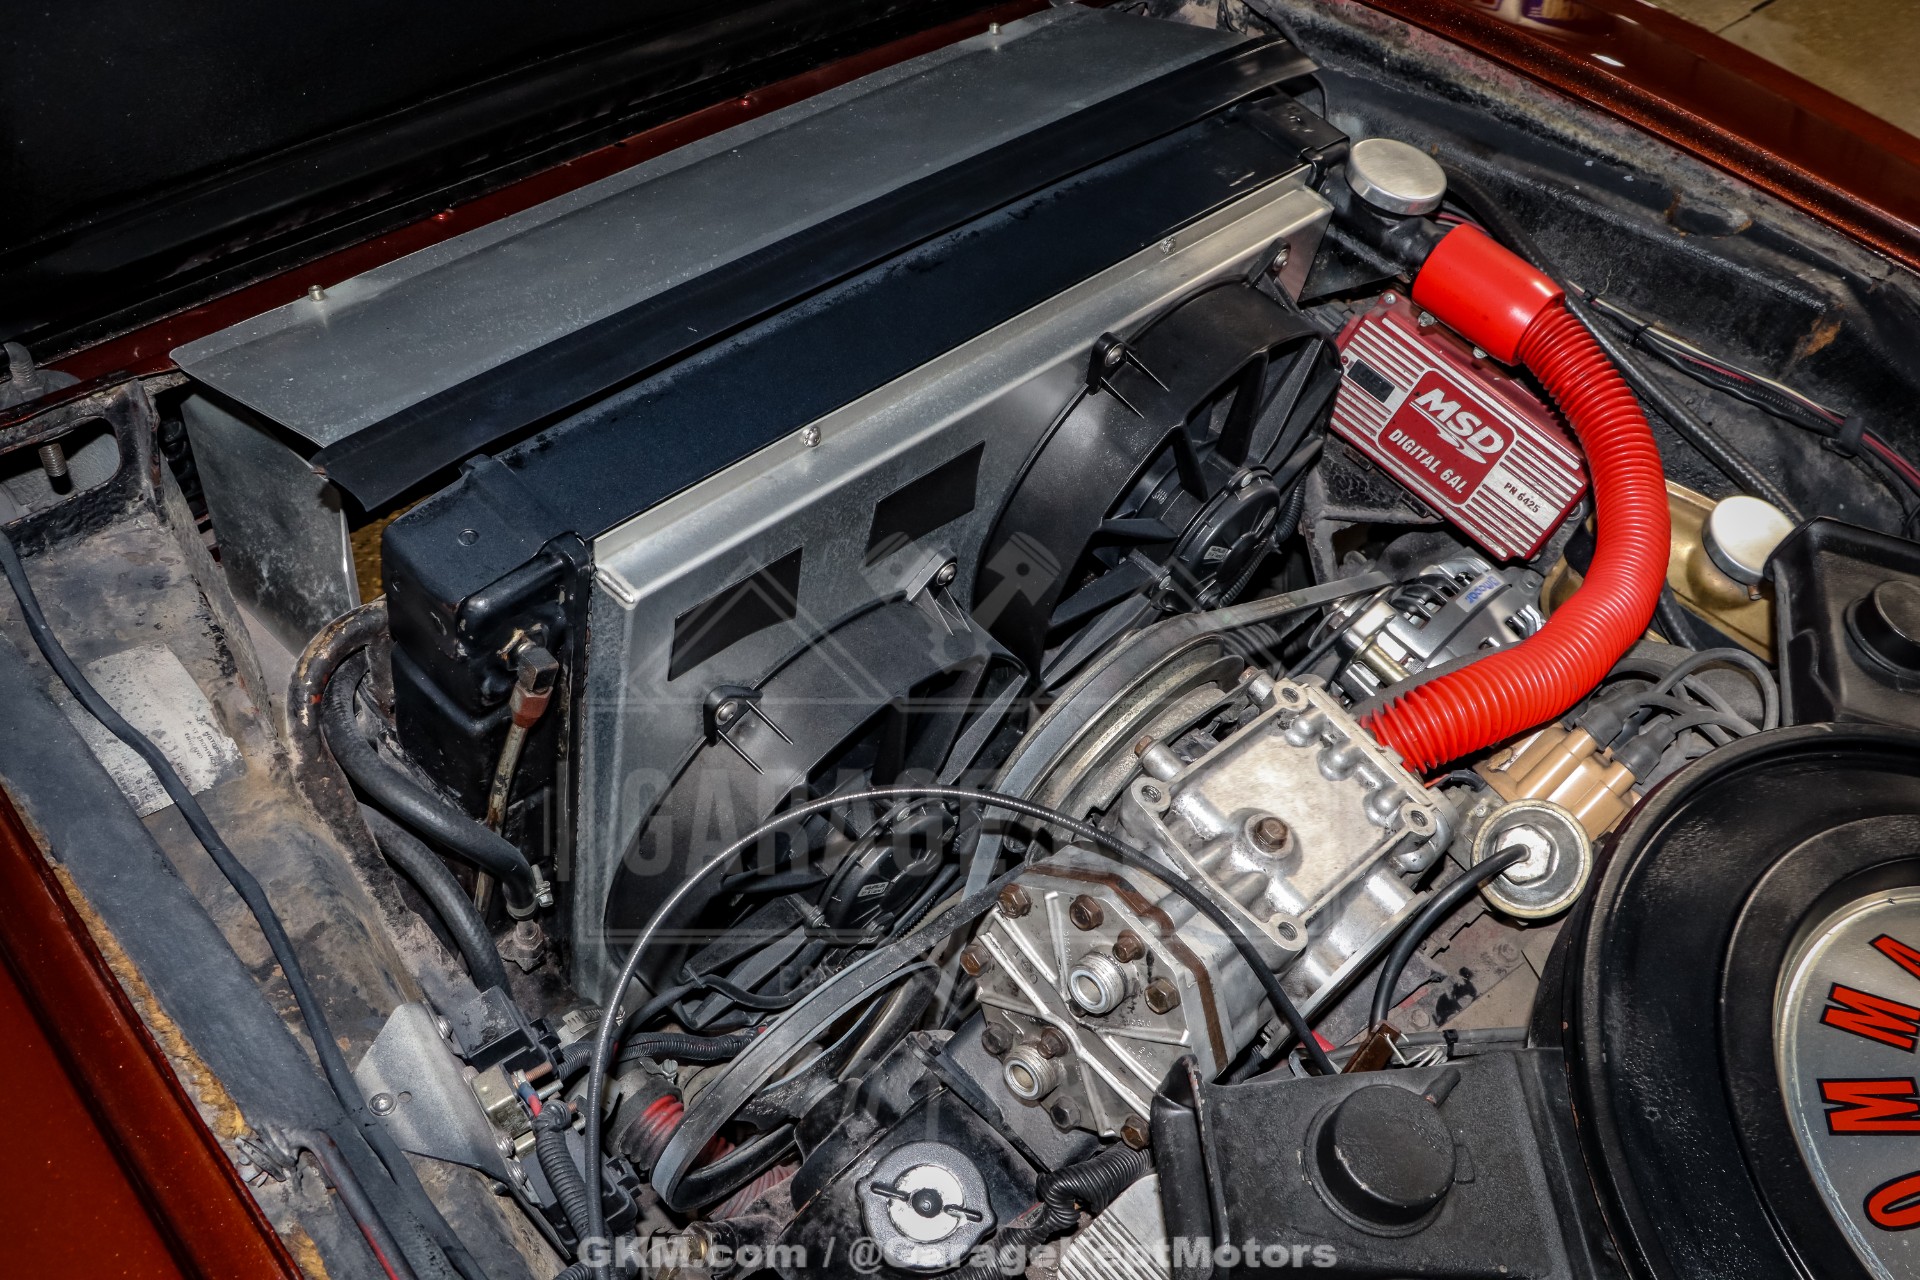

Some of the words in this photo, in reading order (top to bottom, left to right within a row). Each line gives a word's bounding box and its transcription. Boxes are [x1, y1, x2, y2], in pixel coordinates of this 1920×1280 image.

[1415, 387, 1505, 454] MSD
[1388, 429, 1439, 475] DIGITAL
[1440, 469, 1467, 494] 6AL
[1503, 482, 1519, 496] PN
[1516, 490, 1541, 514] 6425
